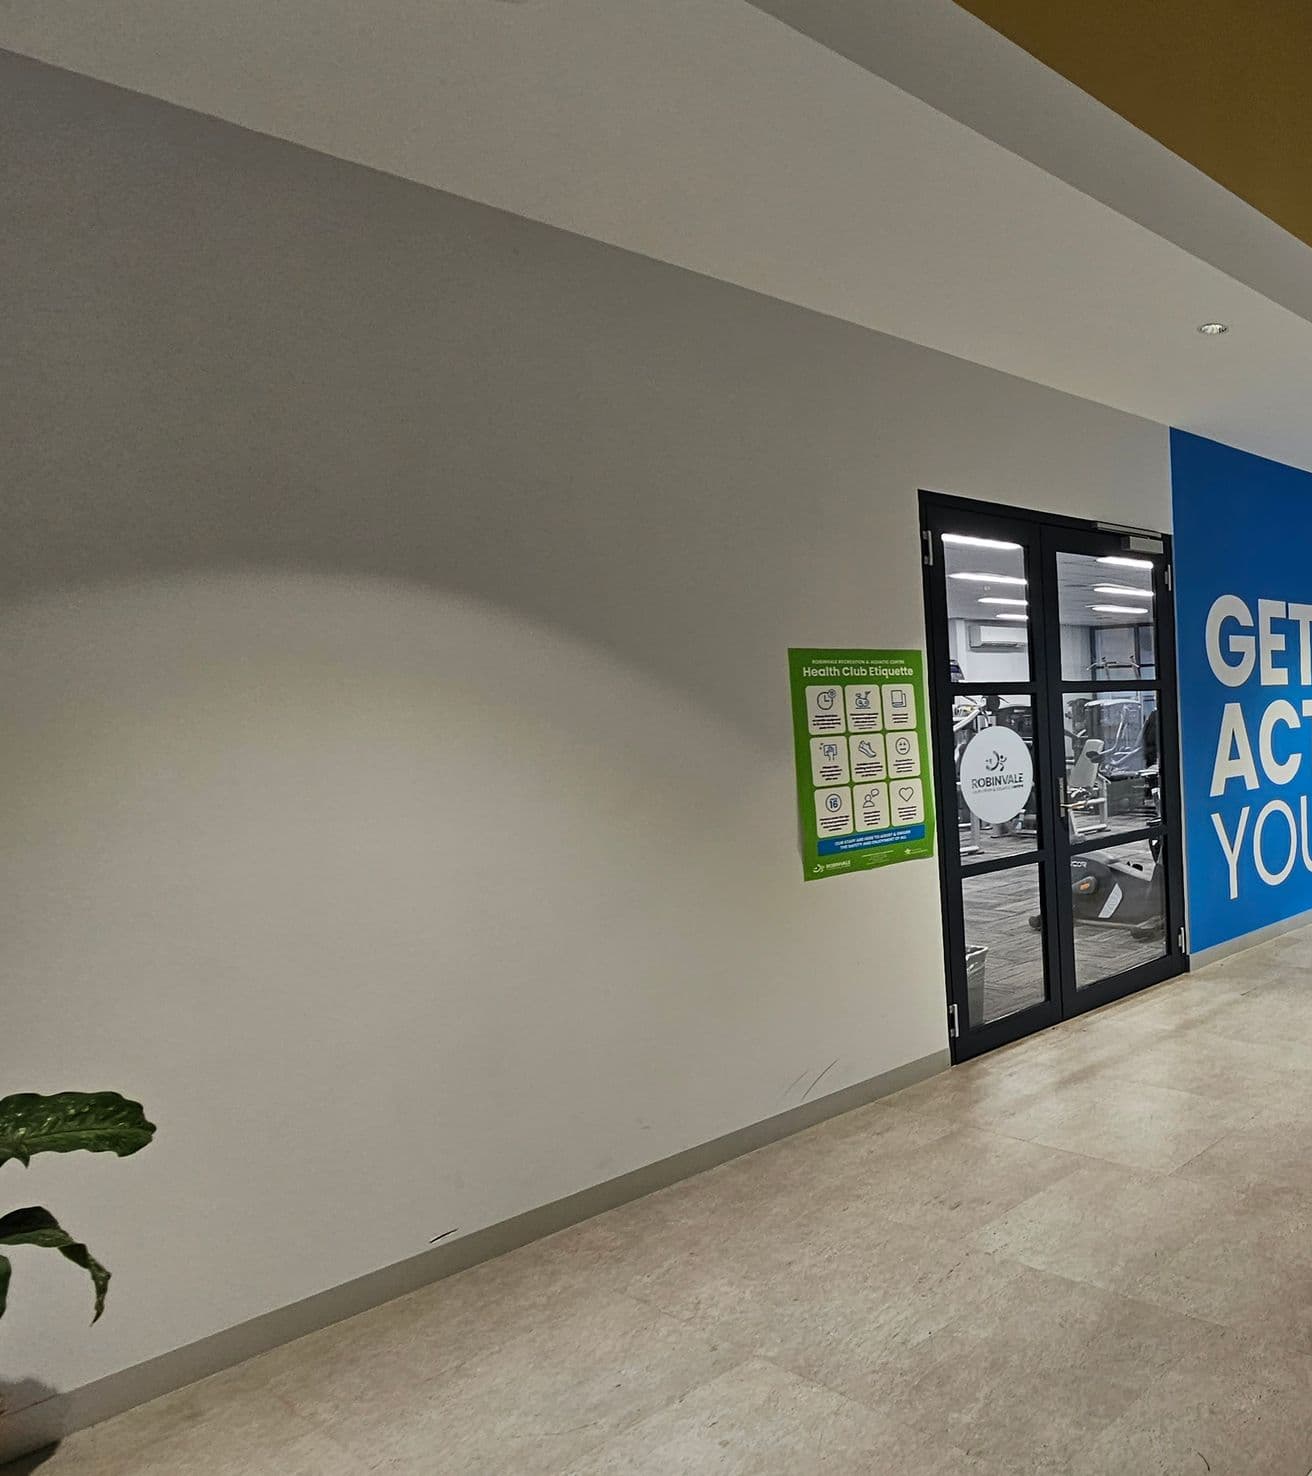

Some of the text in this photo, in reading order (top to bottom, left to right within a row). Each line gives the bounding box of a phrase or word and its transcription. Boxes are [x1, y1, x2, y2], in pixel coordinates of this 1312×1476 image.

[803, 665, 914, 679] Health Club Etiquette
[971, 772, 1024, 789] ROBINVALE
